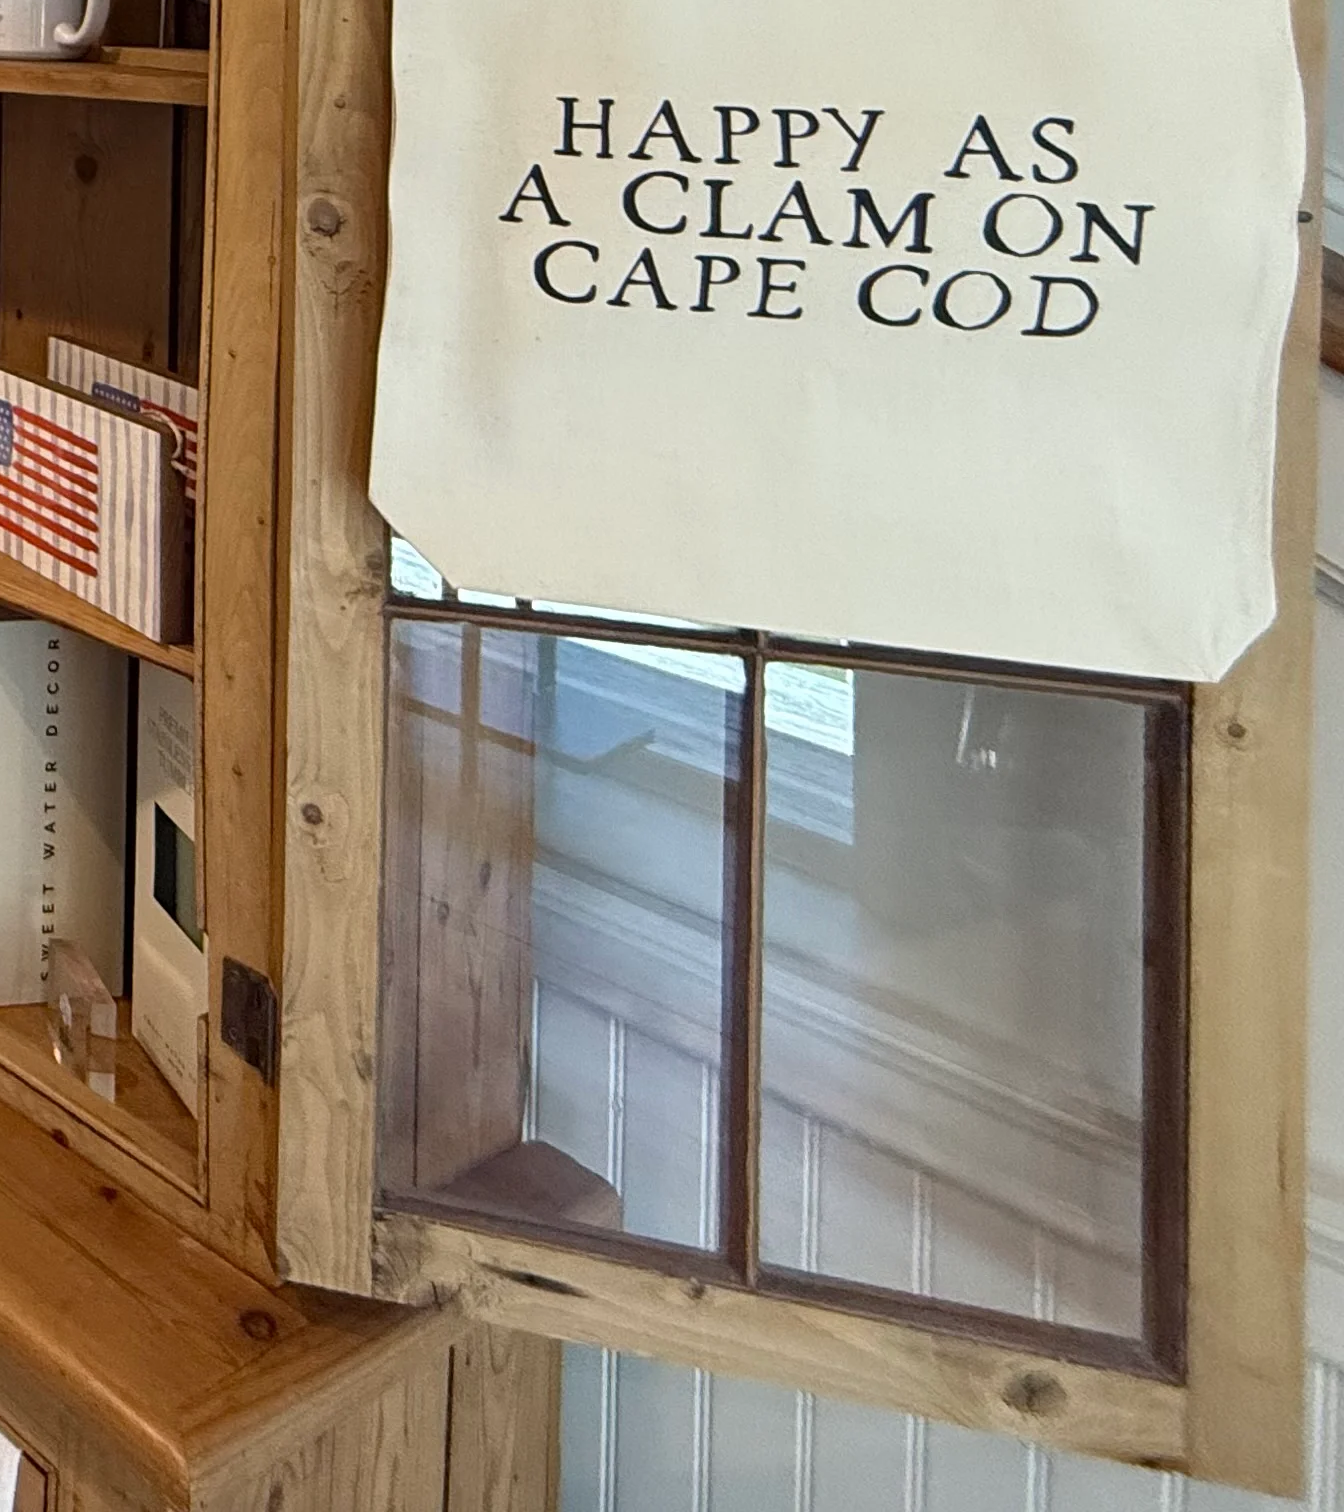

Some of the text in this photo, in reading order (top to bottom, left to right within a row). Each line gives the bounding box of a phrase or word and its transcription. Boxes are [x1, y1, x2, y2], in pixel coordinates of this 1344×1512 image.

[553, 96, 1078, 186] HAPPY AS
[499, 164, 1155, 266] A CLAM ON
[532, 240, 1100, 338] CAPE COD
[46, 638, 60, 738] DECOR
[43, 761, 58, 860] WATER
